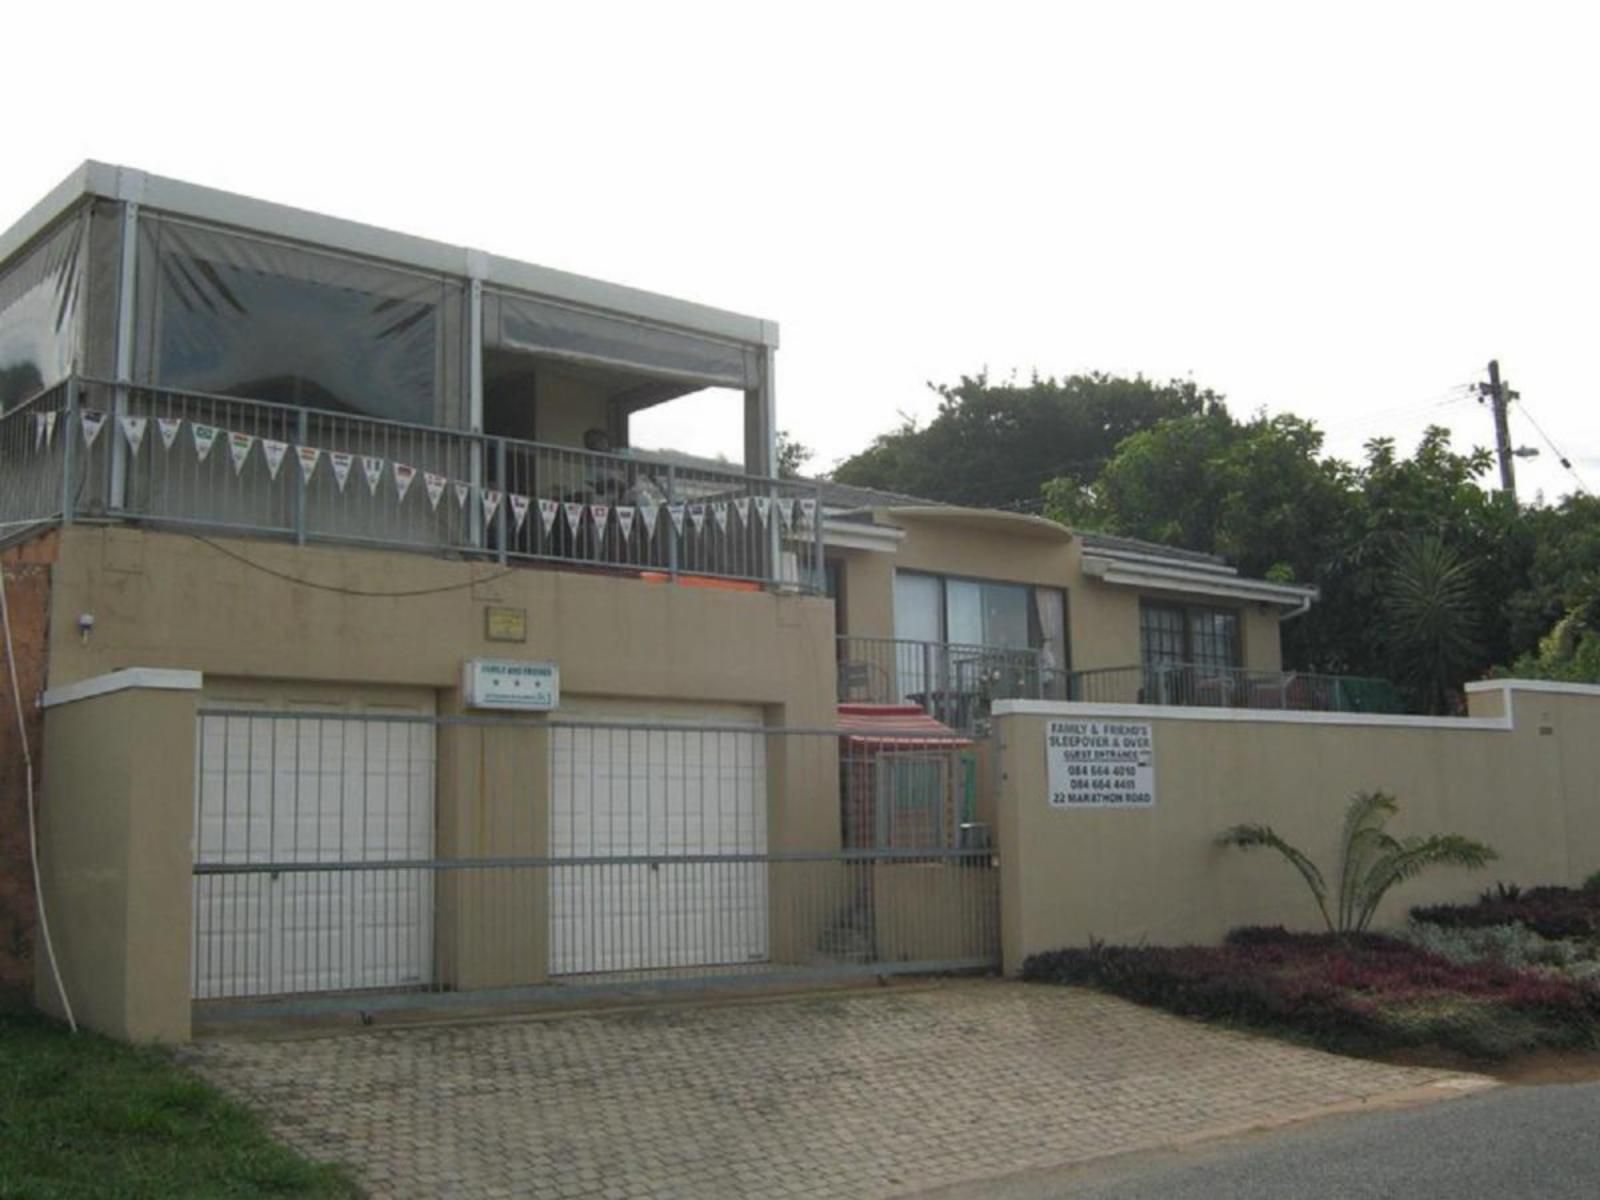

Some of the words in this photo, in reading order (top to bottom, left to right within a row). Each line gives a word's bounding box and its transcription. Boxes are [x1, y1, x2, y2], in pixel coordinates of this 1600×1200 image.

[1051, 723, 1087, 734] FAMILY
[1091, 724, 1098, 735] &
[1049, 735, 1108, 747] SLEEPOVER
[1113, 738, 1120, 748] &
[1064, 750, 1091, 759] GUEST
[1095, 750, 1138, 760] ENTRANCE
[1068, 765, 1087, 776] 084
[1070, 779, 1089, 789] 084
[1053, 792, 1065, 803] 22
[1068, 793, 1123, 803] MARATHON
[1125, 793, 1151, 803] ROAD
